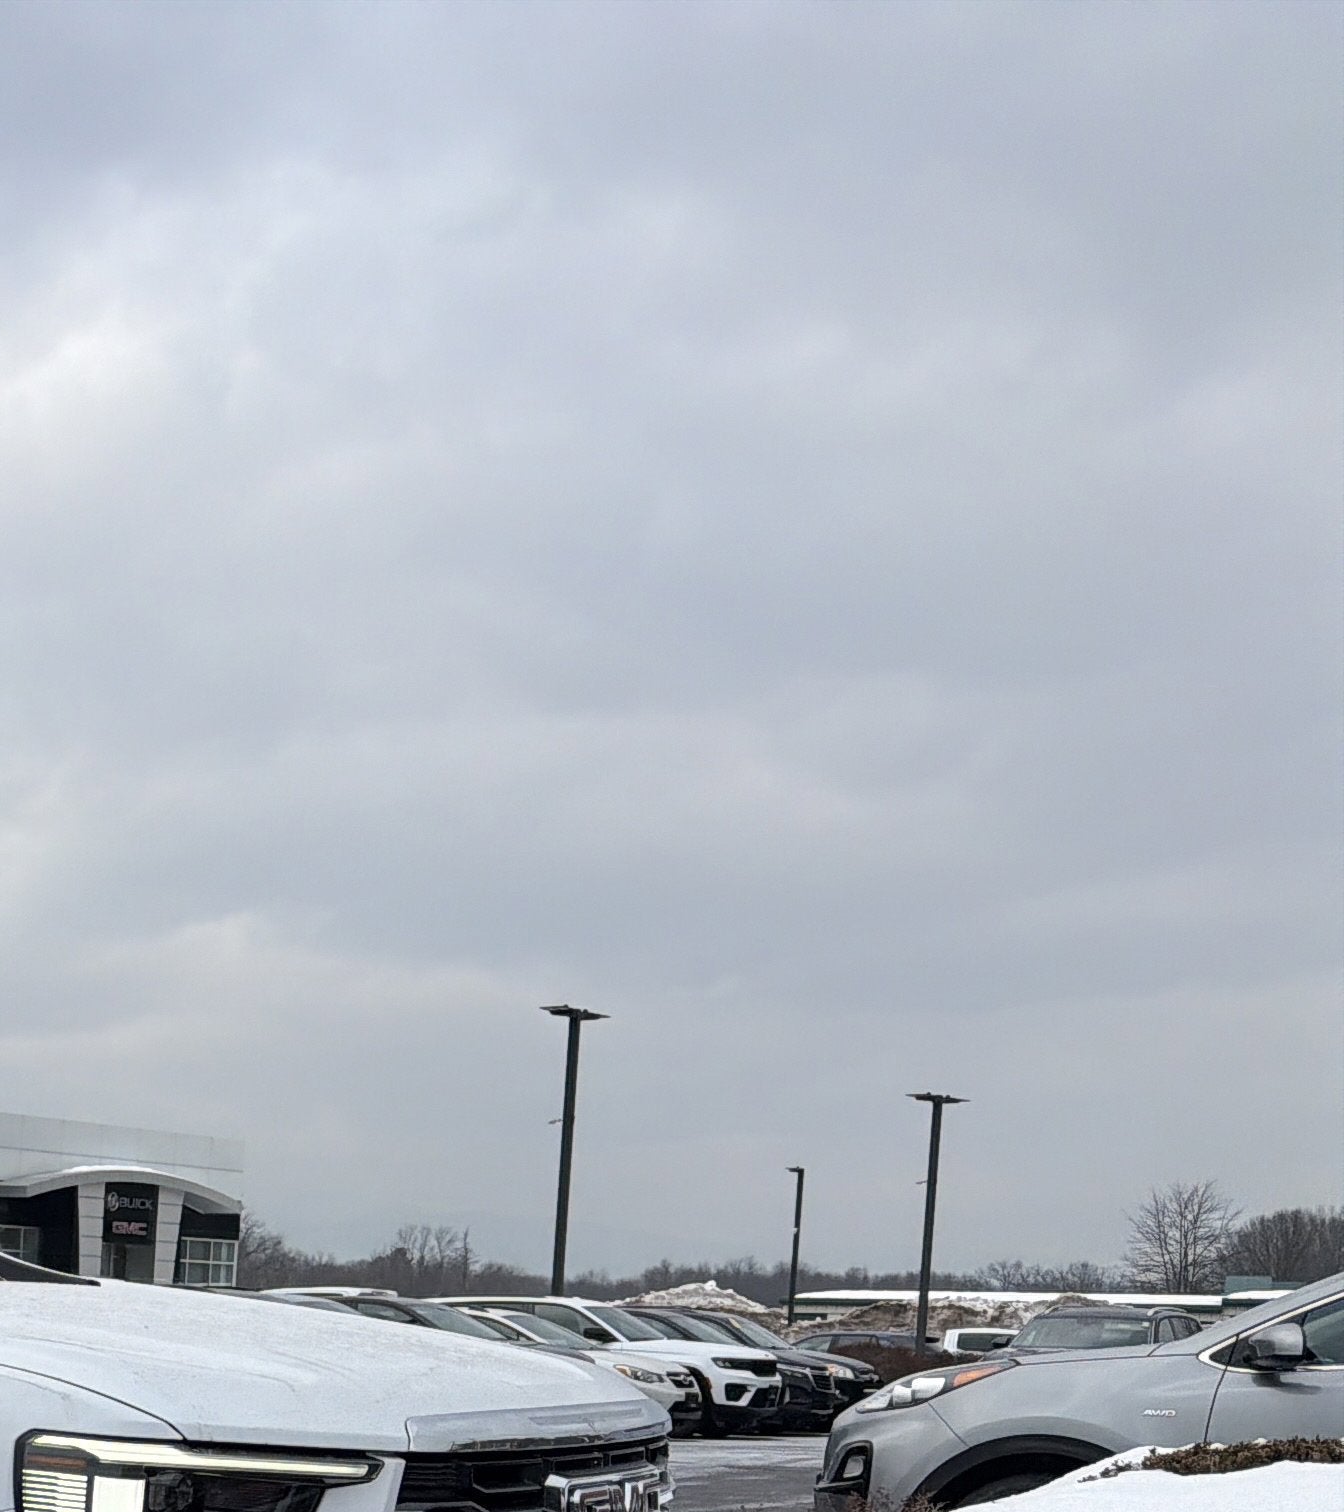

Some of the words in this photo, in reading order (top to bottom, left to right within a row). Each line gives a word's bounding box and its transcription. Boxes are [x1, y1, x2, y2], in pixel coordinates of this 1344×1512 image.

[119, 1196, 153, 1210] BUICK
[112, 1221, 148, 1236] GMC
[1143, 1409, 1177, 1417] AWD
